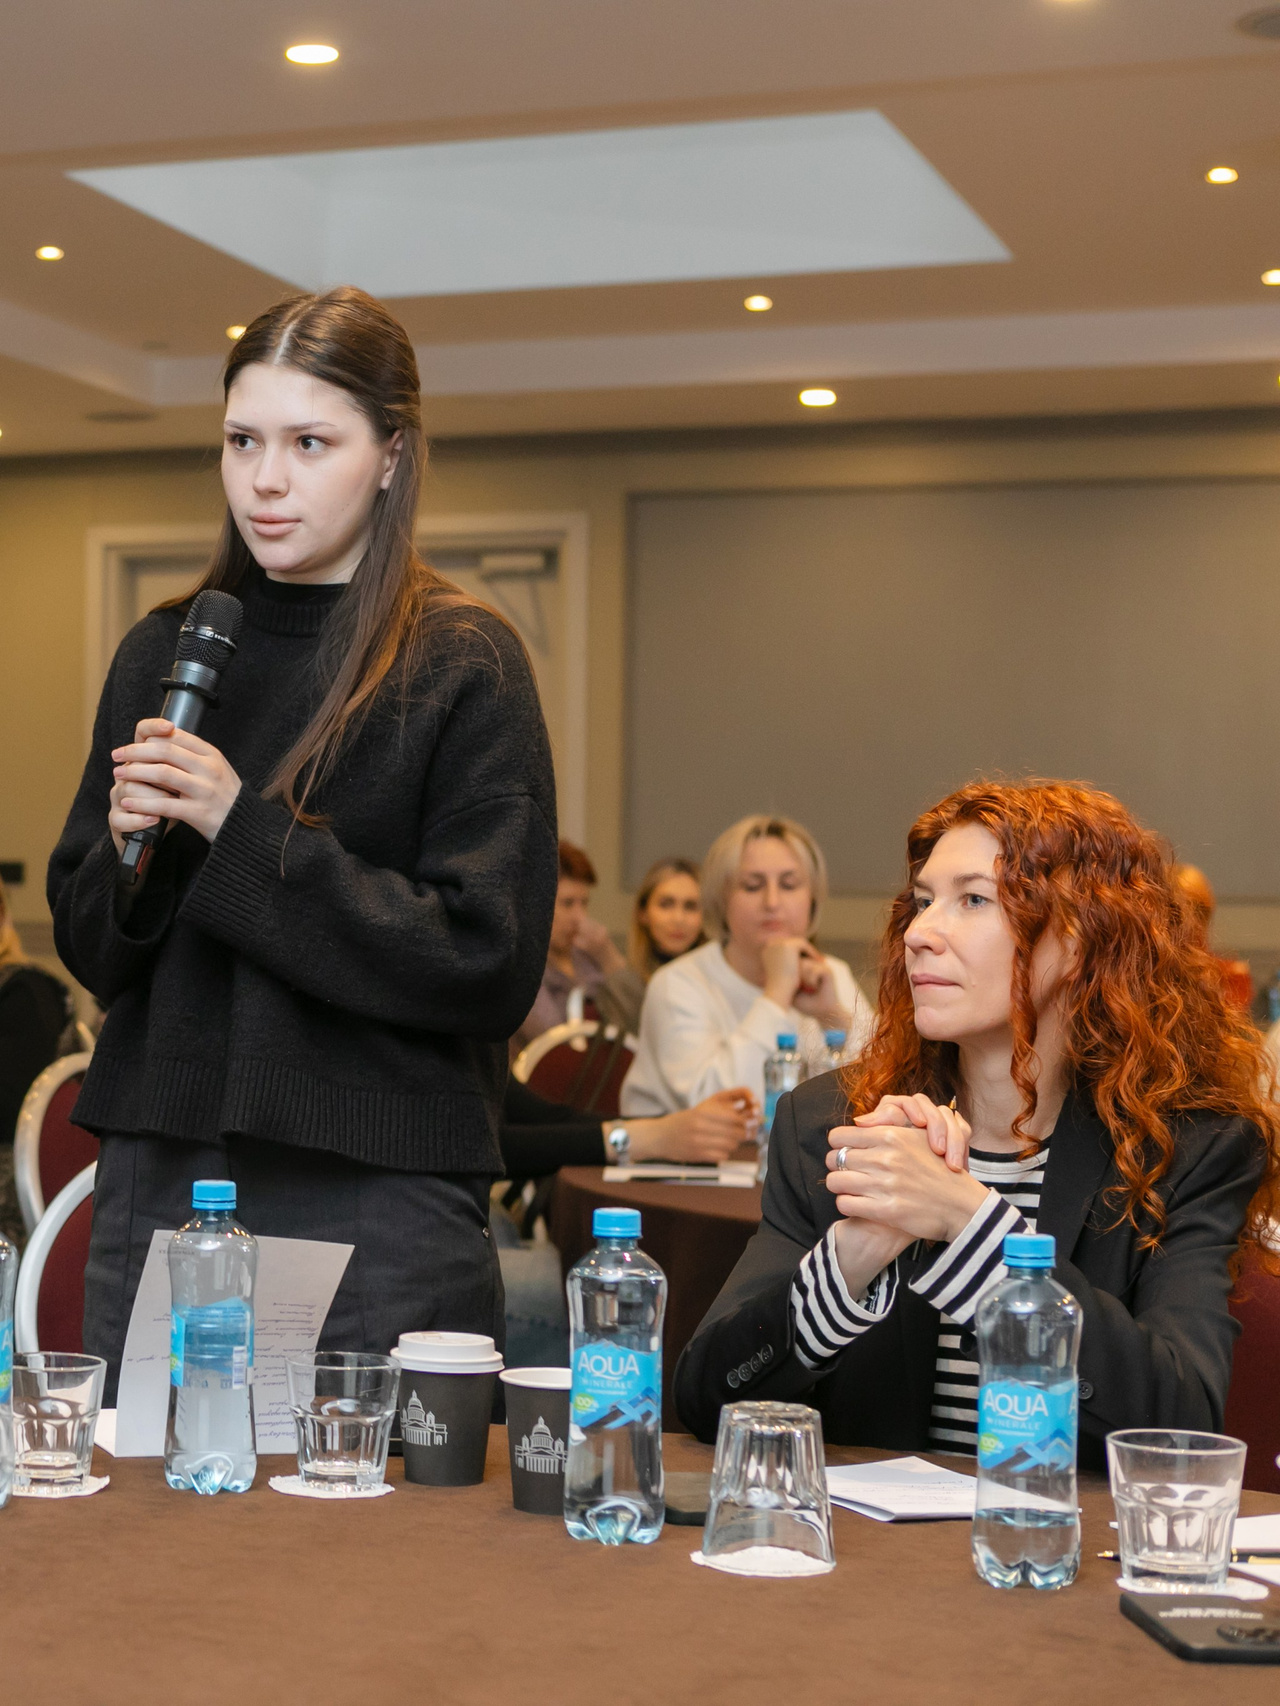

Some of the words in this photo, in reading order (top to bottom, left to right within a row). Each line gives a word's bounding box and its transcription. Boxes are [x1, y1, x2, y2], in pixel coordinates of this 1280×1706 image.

[578, 1351, 640, 1380] AQUA
[581, 1377, 633, 1390] MINERALE
[983, 1388, 1049, 1421] AQUA
[985, 1417, 1042, 1431] MINERALE
